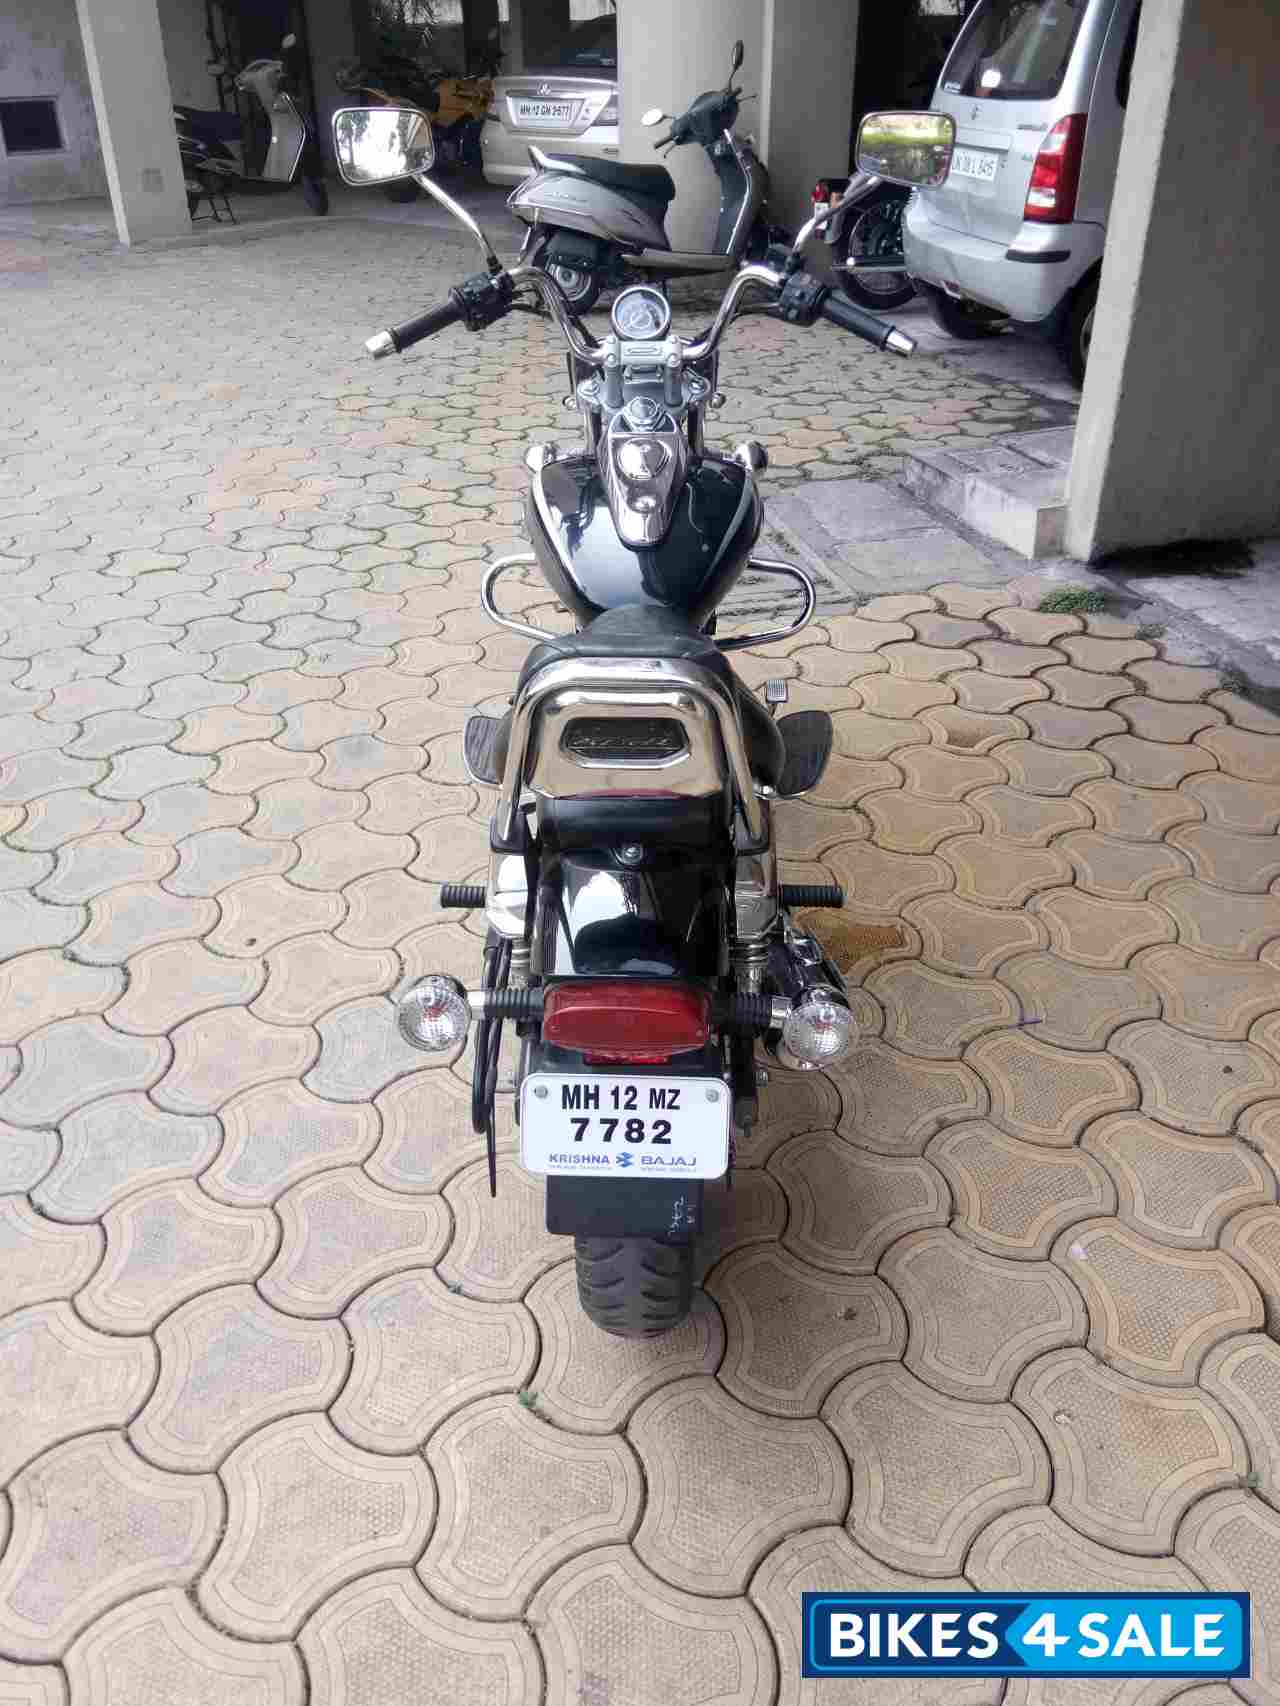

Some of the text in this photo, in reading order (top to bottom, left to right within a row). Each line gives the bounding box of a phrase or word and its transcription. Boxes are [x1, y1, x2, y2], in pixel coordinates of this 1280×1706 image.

[562, 1085, 680, 1110] MH 12 MZ
[570, 1118, 671, 1144] 7782
[549, 1153, 696, 1167] KRISHNA BAJAJ
